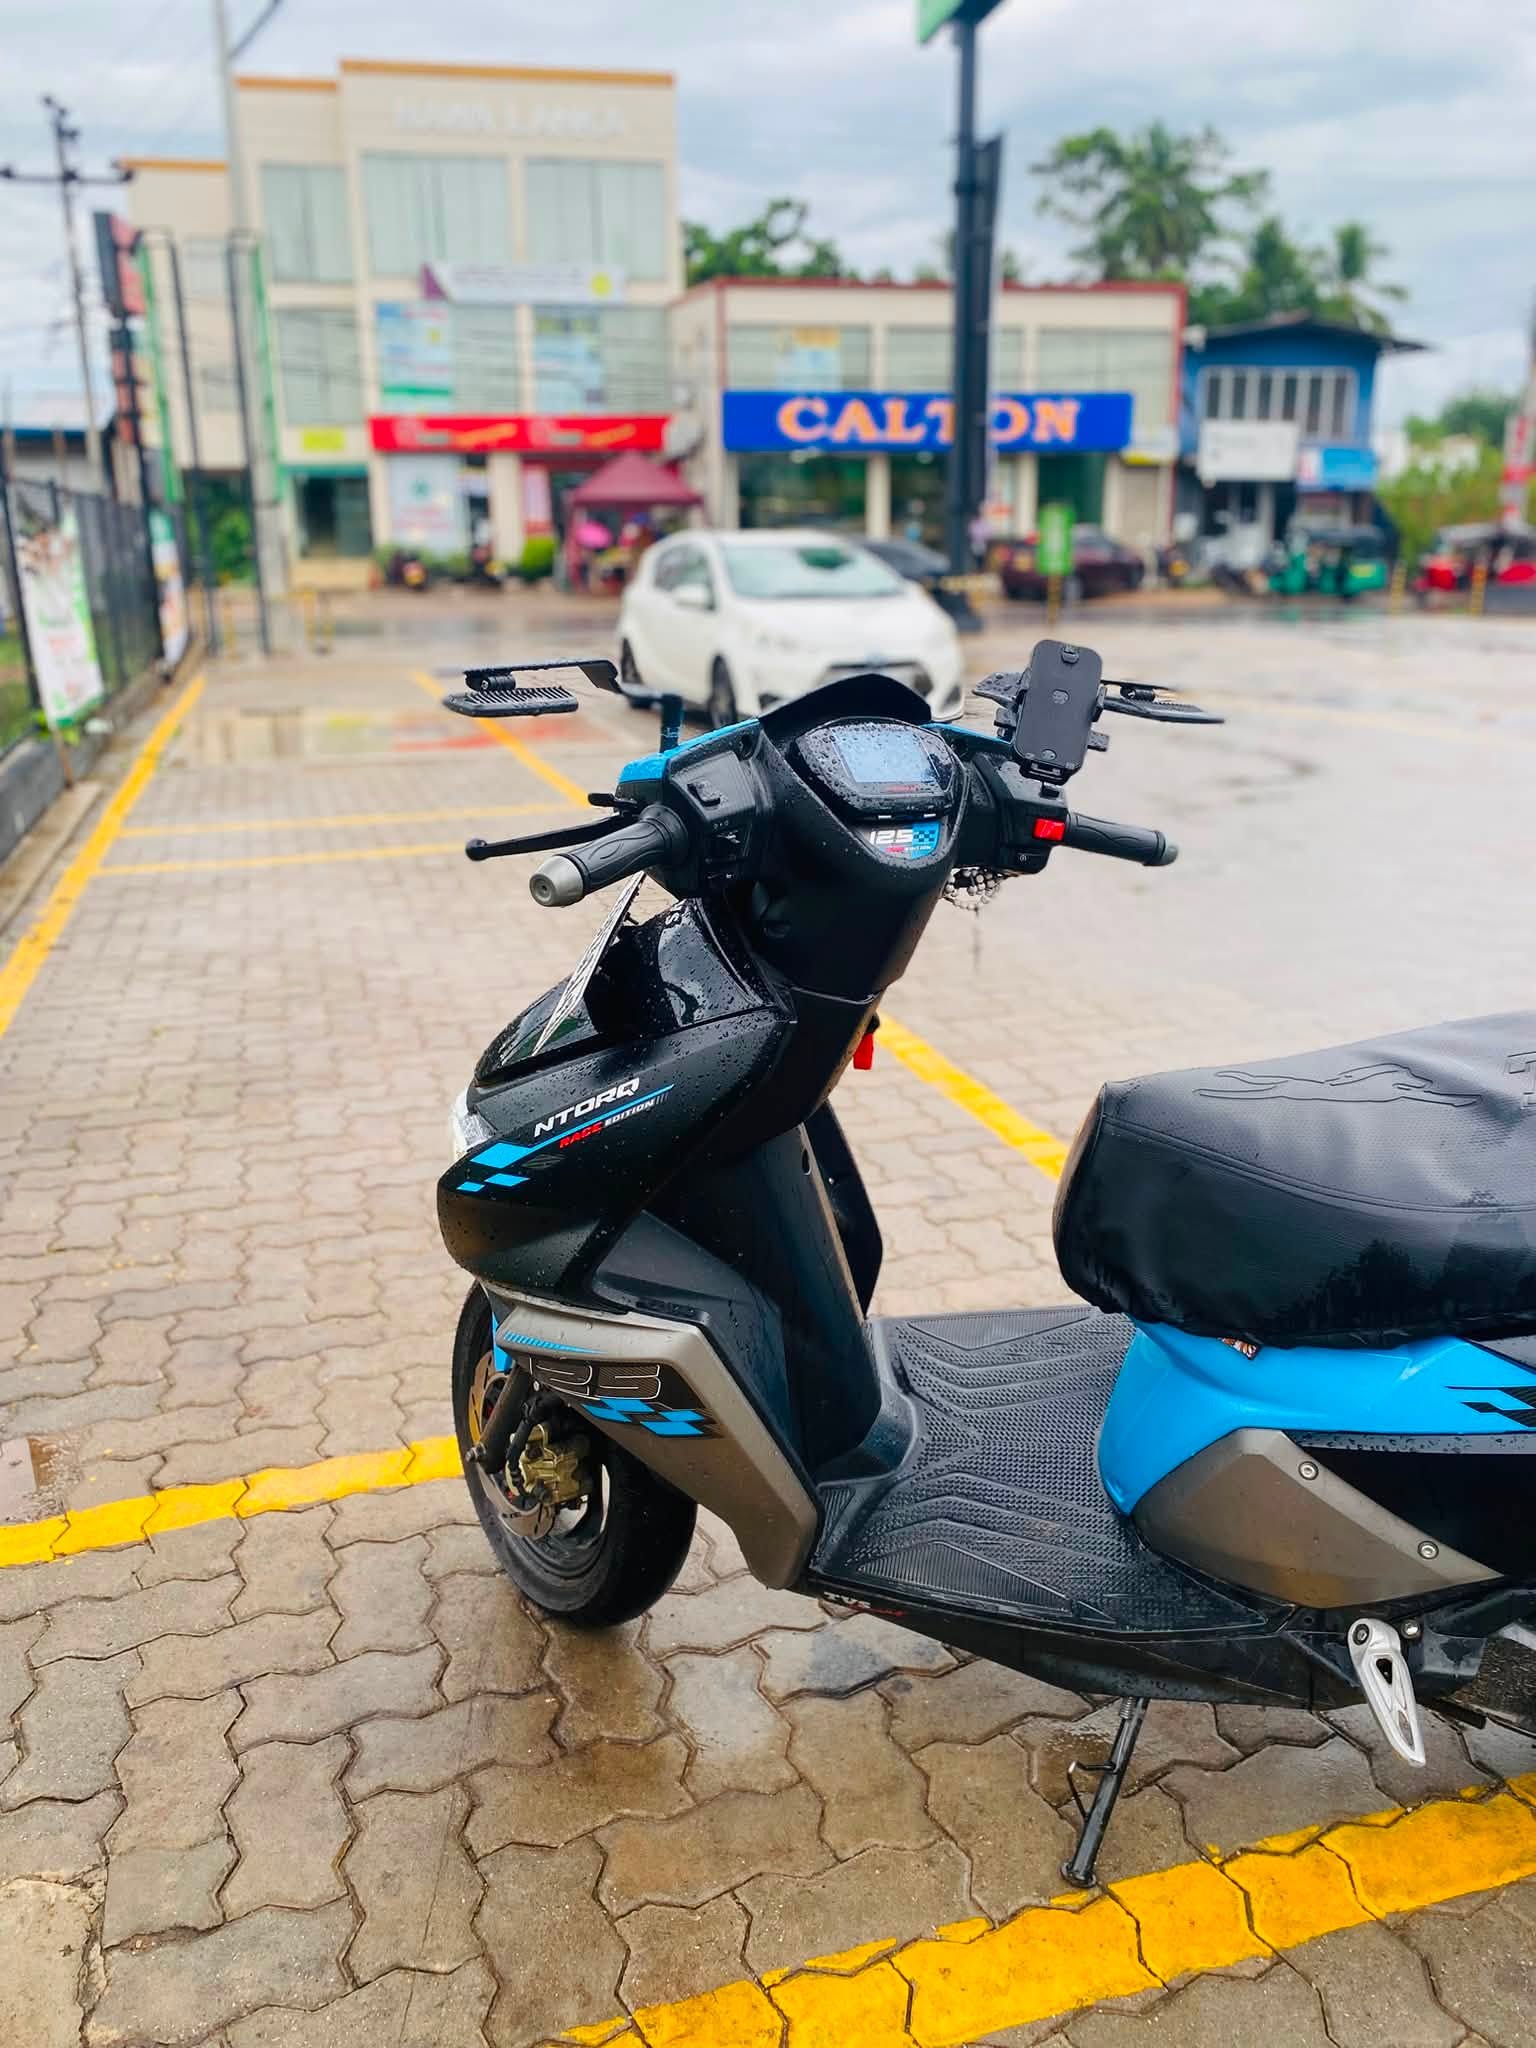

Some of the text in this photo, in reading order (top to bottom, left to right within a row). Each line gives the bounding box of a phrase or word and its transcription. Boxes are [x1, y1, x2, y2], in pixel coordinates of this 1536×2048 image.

[776, 397, 1080, 443] CALTON
[869, 828, 913, 846] 125
[534, 1077, 640, 1138] NTORQ
[559, 1097, 656, 1149] RACE EDITION
